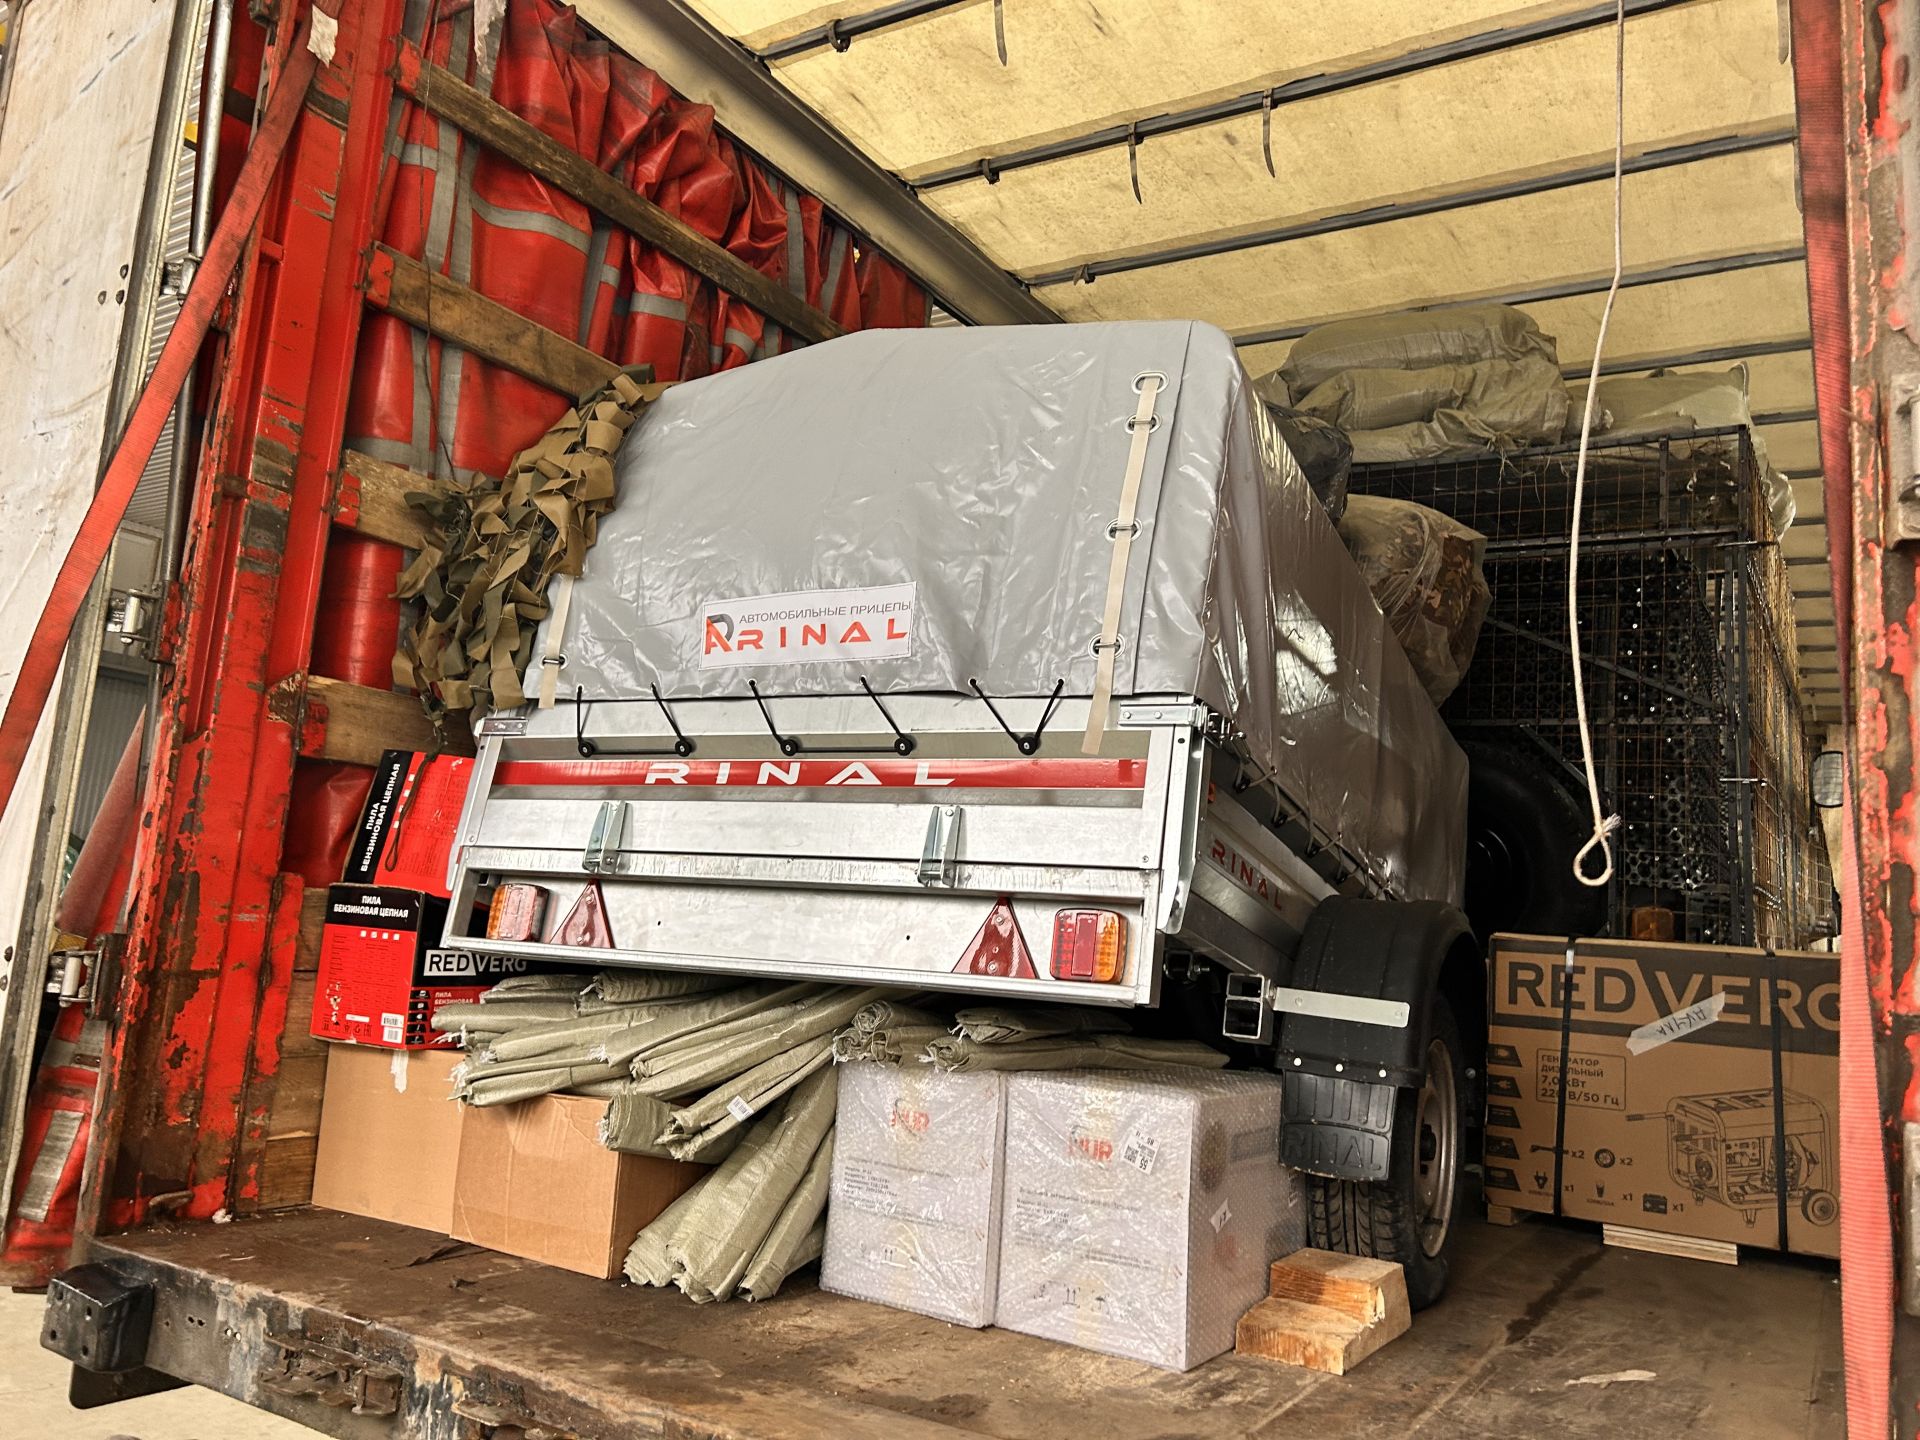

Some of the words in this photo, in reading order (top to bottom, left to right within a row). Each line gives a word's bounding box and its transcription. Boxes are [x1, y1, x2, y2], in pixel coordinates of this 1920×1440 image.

[739, 606, 846, 624] АВТОМОБИЛЬНЫЕ
[850, 600, 911, 616] ПРИЦЕПЫ
[737, 617, 908, 651] RINAL
[644, 761, 956, 785] RINAL
[360, 804, 388, 872] БЕНЗИНОВАЯ
[382, 763, 401, 803] ЦЕПНАЯ
[365, 802, 380, 830] ПИЛА
[1212, 838, 1282, 911] RINAL
[333, 903, 379, 915] БЕНЗИНОВАЯ
[379, 907, 409, 918] ЦЕПНАЯ
[361, 895, 382, 905] ПИЛА
[1541, 1055, 1600, 1066] ГЕНРАТОР
[1604, 1095, 1619, 1106] Гц
[1284, 1127, 1382, 1171] RINAL
